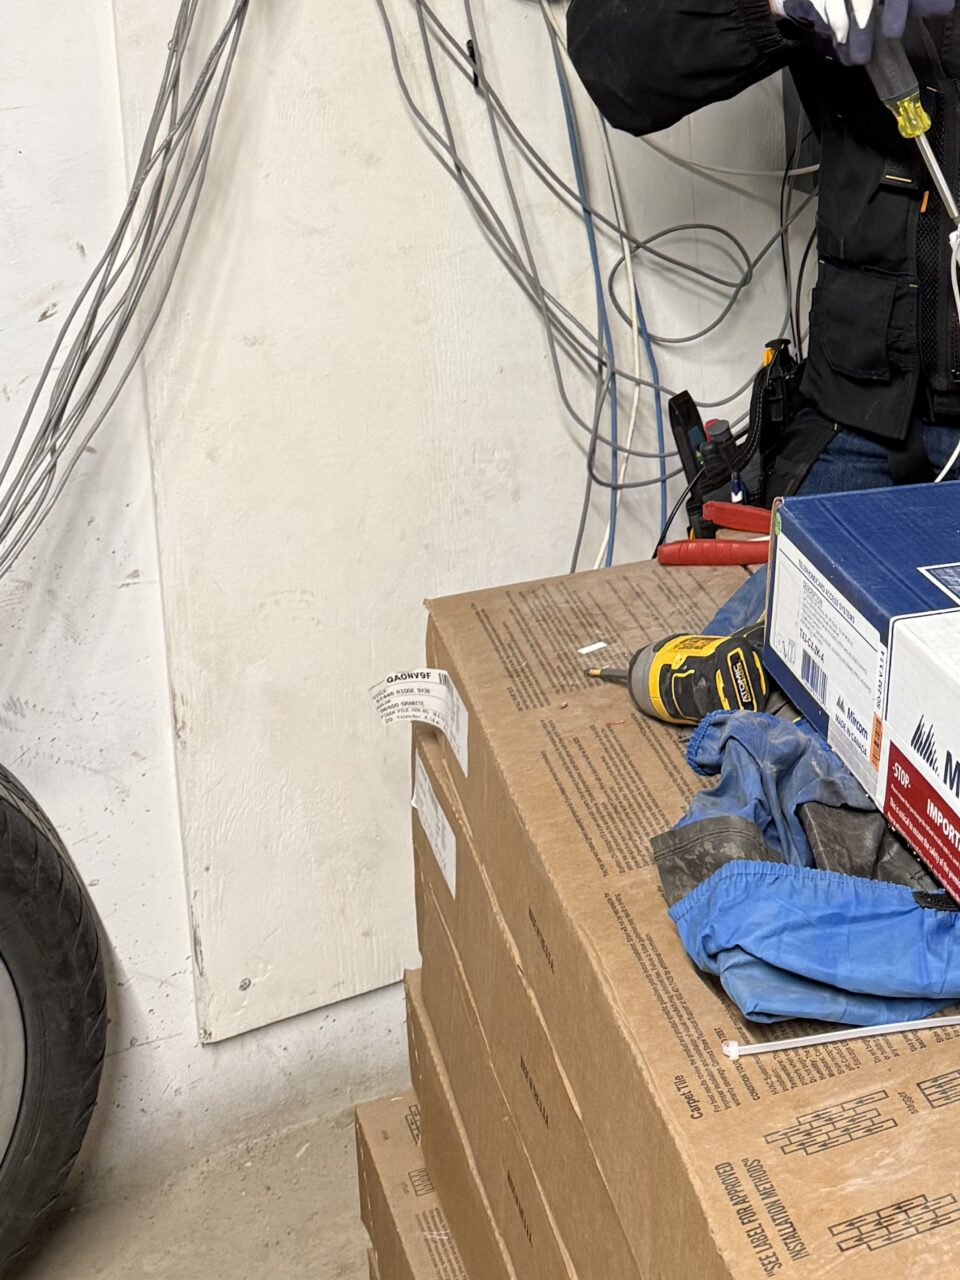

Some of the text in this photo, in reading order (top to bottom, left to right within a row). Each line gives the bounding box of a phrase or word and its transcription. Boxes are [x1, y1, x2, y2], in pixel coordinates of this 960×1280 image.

[733, 664, 750, 702] ATOMIC
[846, 707, 868, 741] Mircom
[674, 1074, 703, 1120] Carpet Tile
[898, 1091, 918, 1114] stagger
[714, 1161, 751, 1207] APPROVED
[736, 1201, 758, 1226] FOR
[764, 1198, 810, 1261] INSTALLATION
[746, 1222, 775, 1255] LABEL
